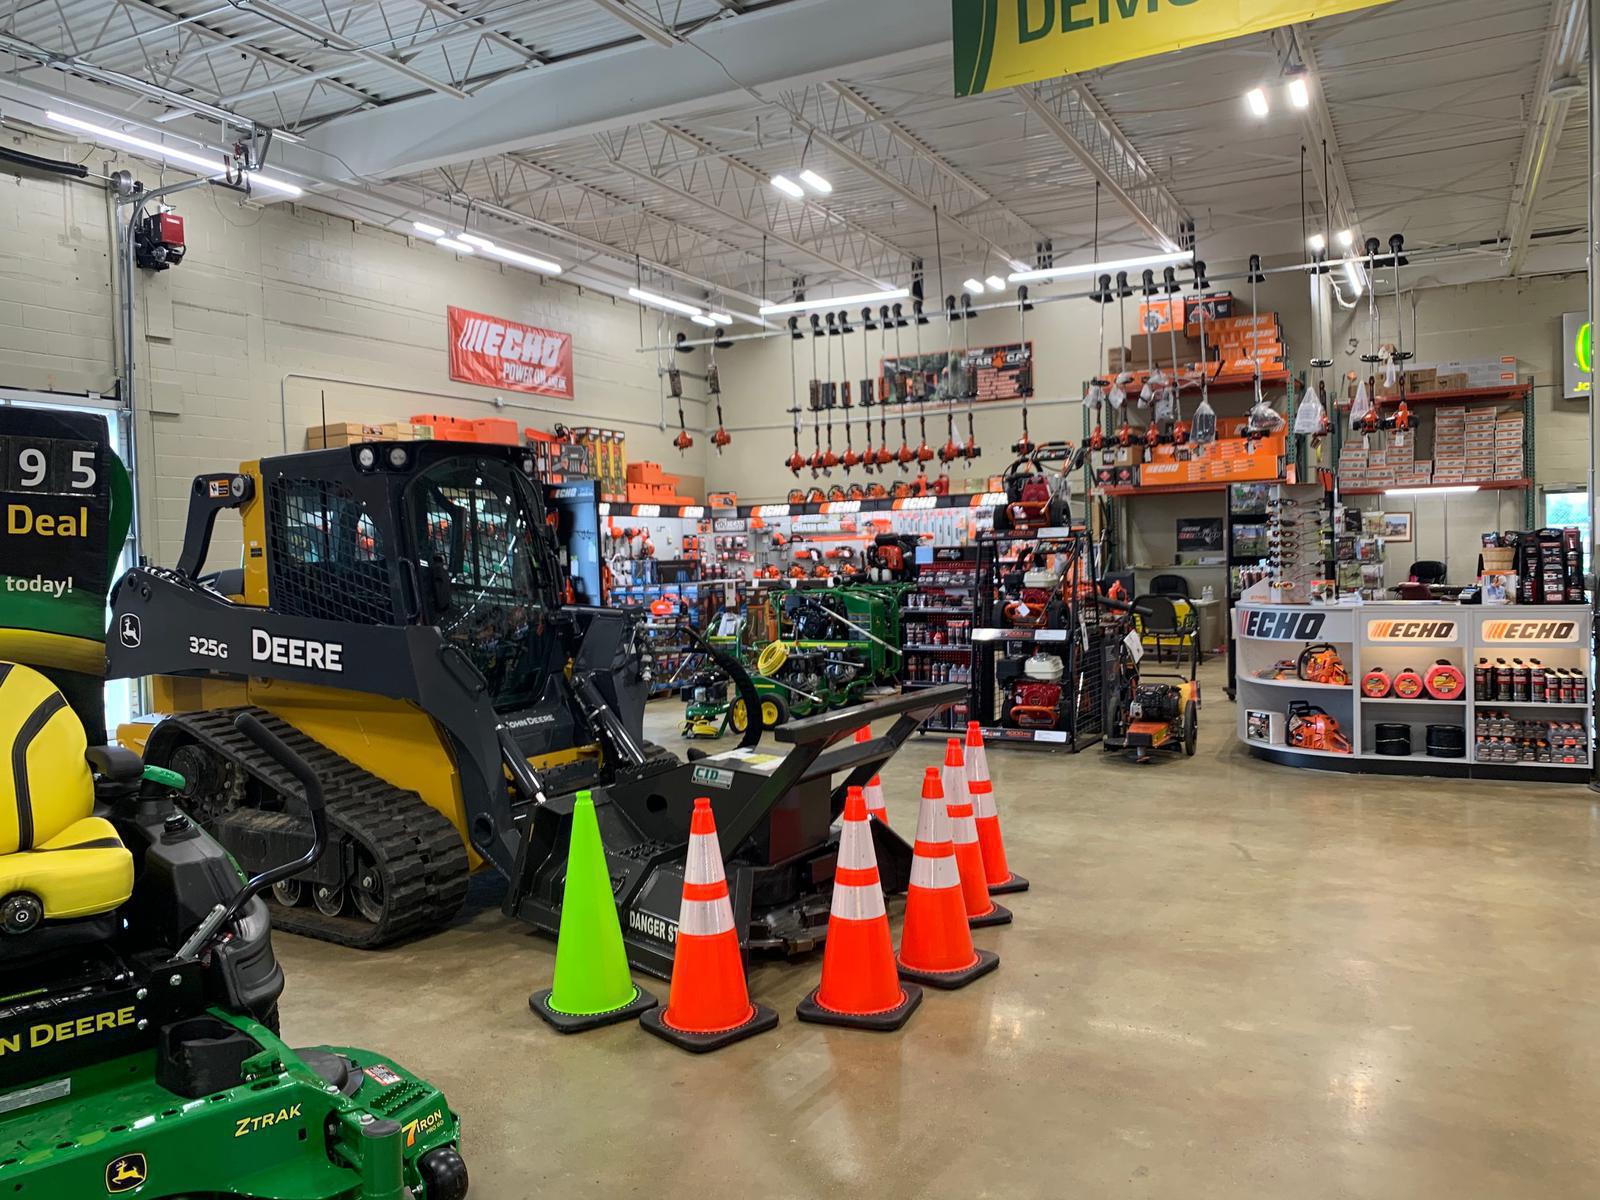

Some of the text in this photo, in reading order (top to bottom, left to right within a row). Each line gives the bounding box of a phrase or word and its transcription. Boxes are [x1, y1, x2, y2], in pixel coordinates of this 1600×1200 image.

[484, 323, 562, 368] ECHO
[8, 504, 87, 537] Deal
[5, 574, 73, 598] today!
[1246, 610, 1326, 640] ECHO
[1389, 622, 1455, 638] ECHO
[1504, 622, 1575, 639] ECHO
[189, 628, 343, 672] 325G DEERE
[526, 713, 555, 726] DEERE
[695, 767, 719, 780] CID
[629, 910, 666, 940] DANGER
[30, 1005, 136, 1049] DEERE
